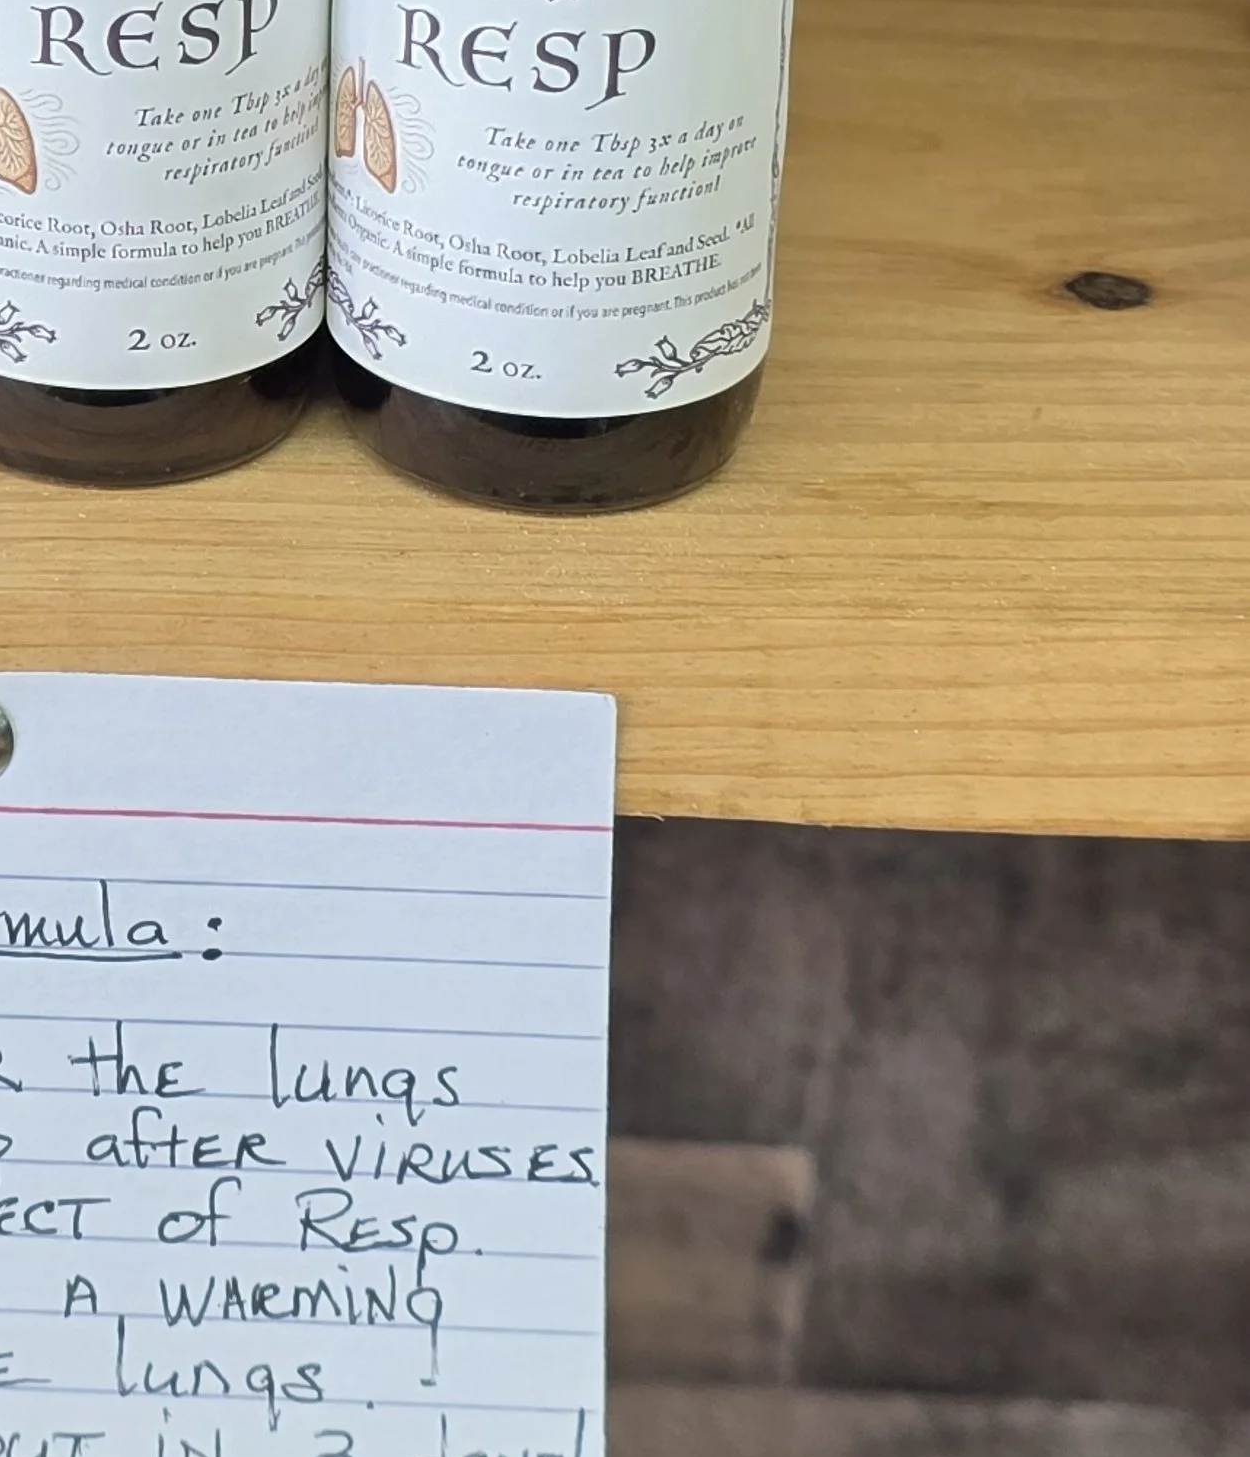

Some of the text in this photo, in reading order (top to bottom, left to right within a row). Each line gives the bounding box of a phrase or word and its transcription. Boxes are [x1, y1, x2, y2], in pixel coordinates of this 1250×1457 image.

[396, 3, 657, 112] RESP
[135, 107, 185, 127] Take
[192, 104, 222, 122] one
[231, 91, 270, 115] Tbsp
[106, 101, 306, 163] tongue or in tea to help
[484, 114, 745, 158] Take one Tbsp 3x a day on
[164, 149, 265, 186] respiratory
[457, 154, 525, 183] tongue
[531, 166, 555, 181] or
[560, 163, 585, 182] in
[592, 166, 625, 182] tea
[633, 163, 652, 180] to
[658, 152, 696, 179] help
[47, 217, 96, 239] Root,
[100, 220, 145, 236] Osha
[150, 219, 198, 236] Root,
[201, 204, 257, 230] Lobelia
[259, 189, 289, 215] Leaf
[512, 174, 722, 216] respiratory function!
[35, 242, 50, 255] A
[52, 242, 107, 262] simple
[111, 243, 177, 259] formula
[181, 243, 198, 255] to
[202, 234, 235, 253] help
[237, 227, 263, 250] you
[128, 329, 198, 351] 2 oz.
[471, 350, 543, 381] 2 oz.
[268, 1022, 461, 1126] lungs
[158, 1174, 241, 1248] of
